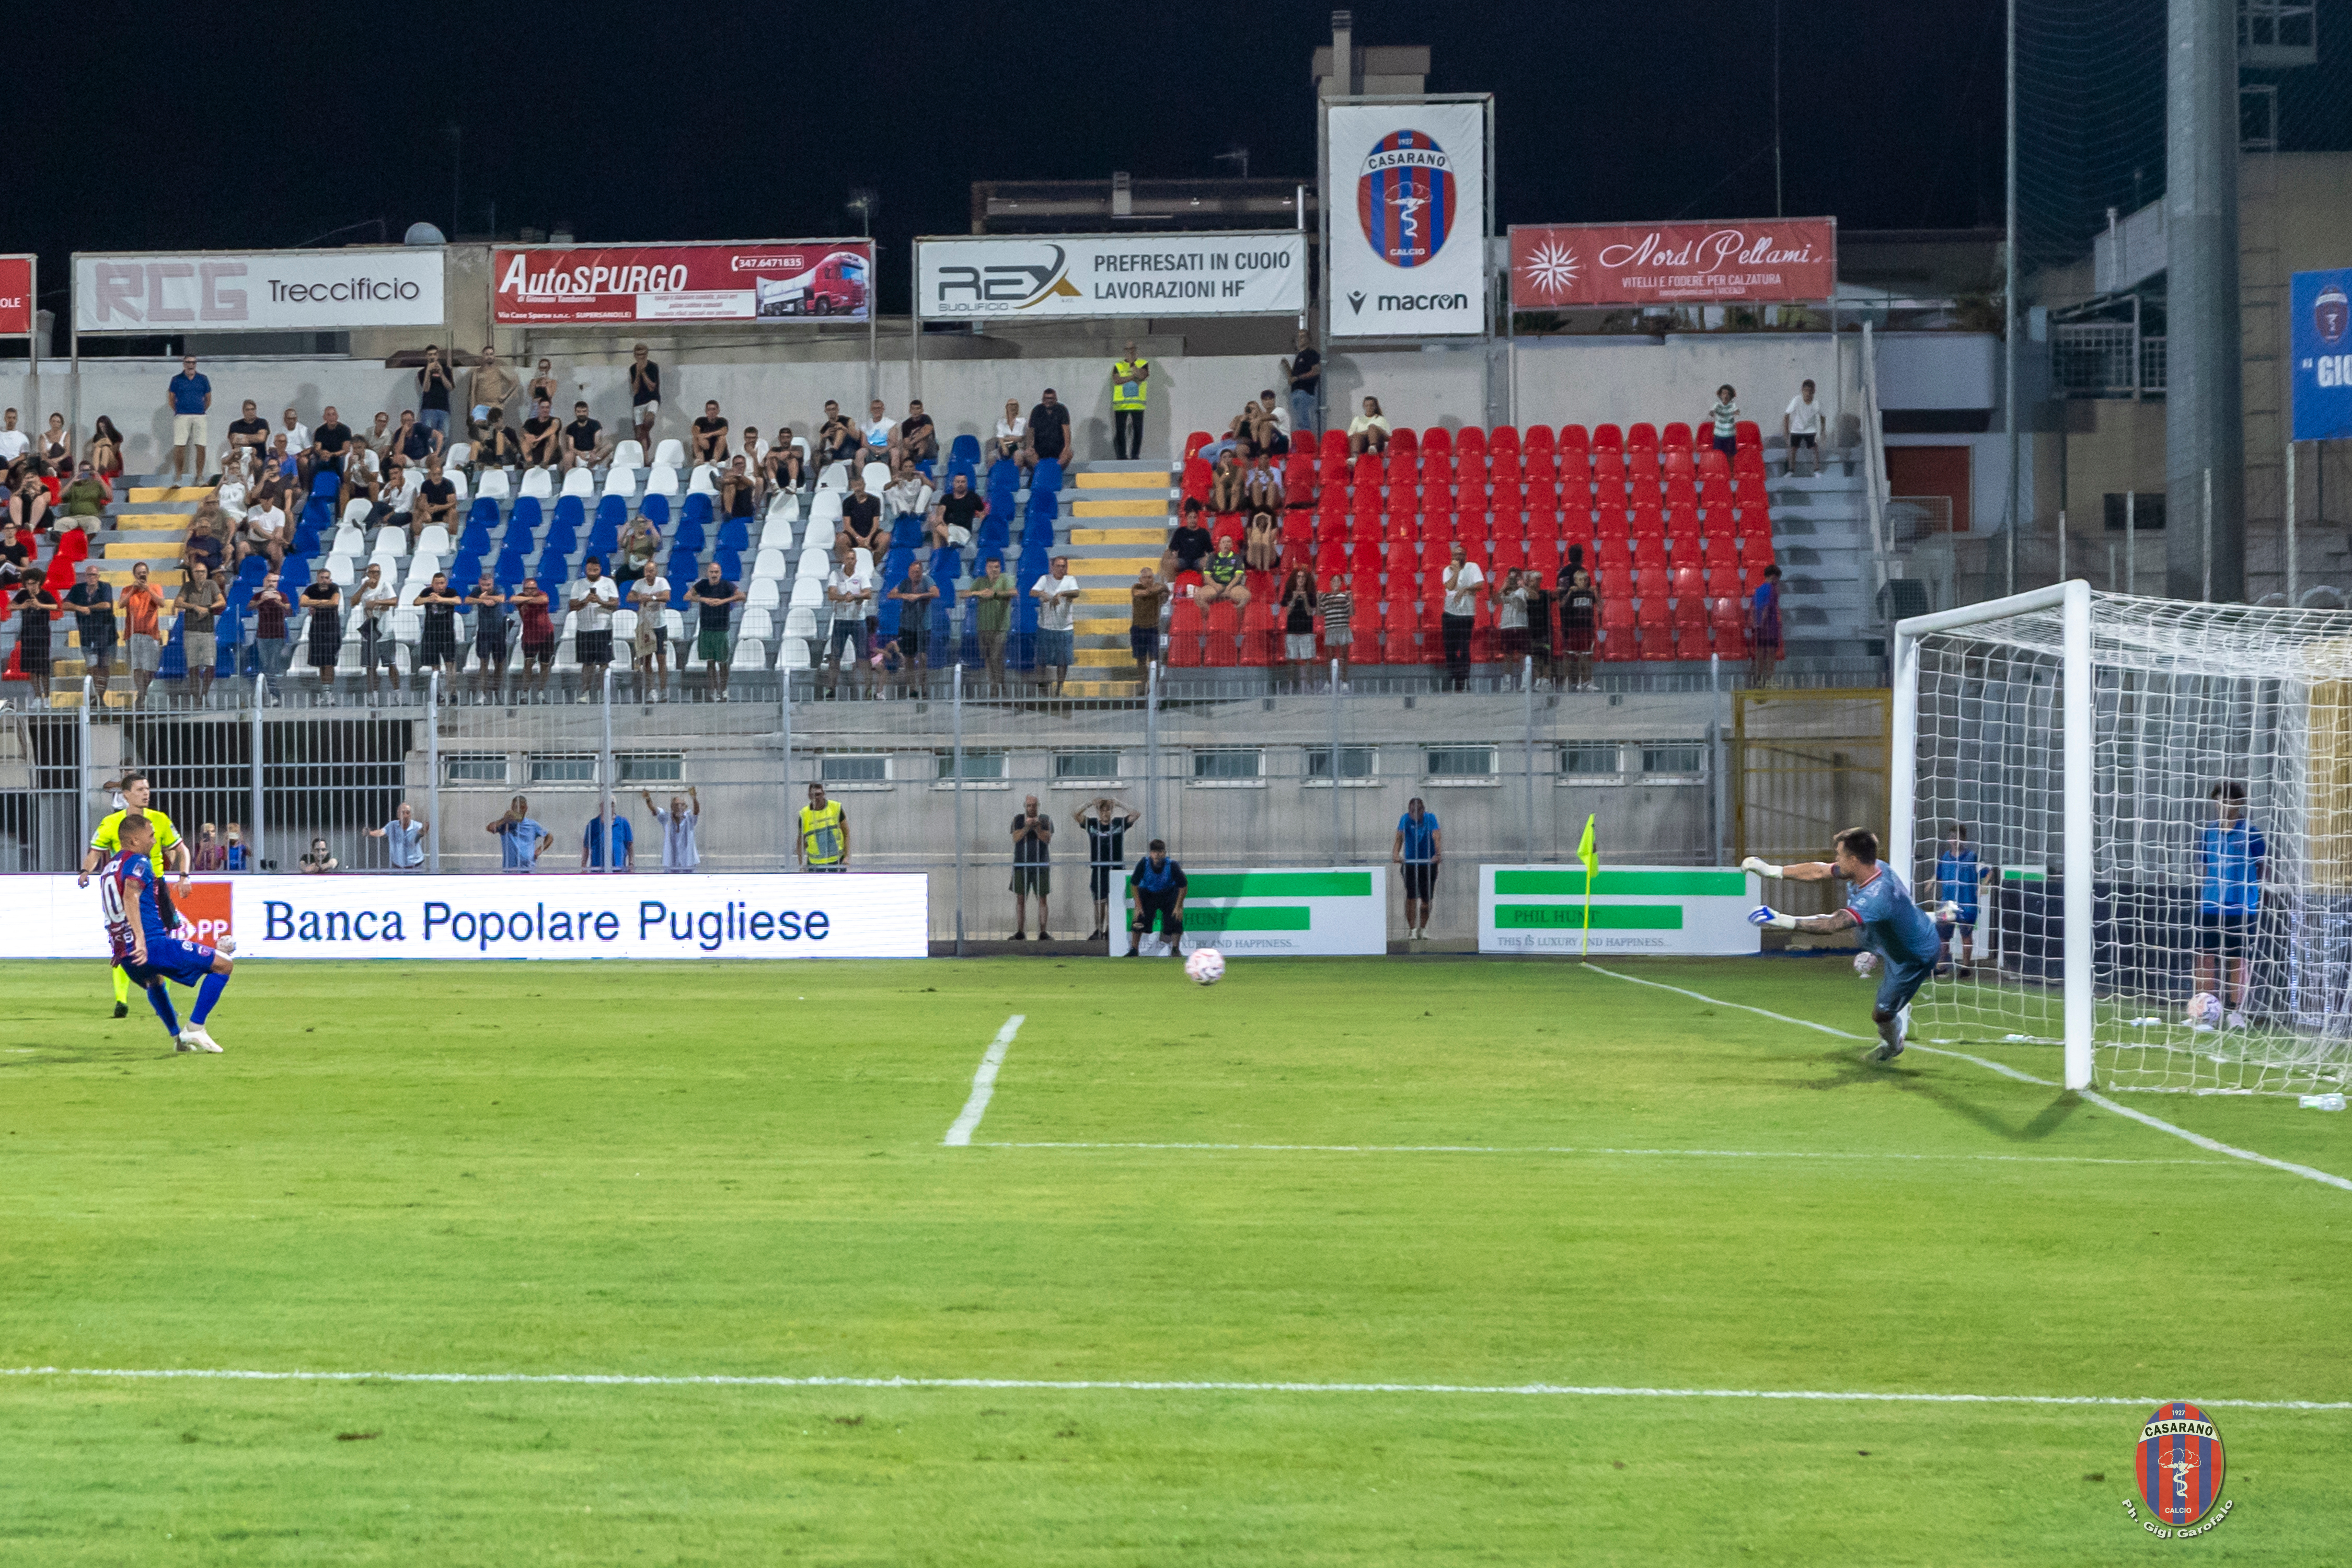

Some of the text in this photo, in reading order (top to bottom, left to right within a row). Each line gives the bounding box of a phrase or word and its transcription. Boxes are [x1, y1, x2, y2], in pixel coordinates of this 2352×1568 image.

[1368, 153, 1446, 170] CASARANO
[1389, 248, 1425, 256] CALCIO
[1599, 229, 1812, 274] Nord Pellami
[1094, 251, 1290, 272] PREFRESATI IN CUOIO
[498, 253, 688, 294] AutoSPURGO
[939, 244, 1083, 309] REX
[1622, 273, 1781, 288] VITELLI E FODERE PER CALZATURA
[95, 262, 420, 322] RCG Treccificio
[1094, 280, 1246, 299] LAVORAZIONI HF
[939, 303, 1009, 312] SUOLIFICIO
[1378, 293, 1468, 310] macron
[1514, 910, 1549, 923] PHIL
[262, 901, 830, 952] Banca Popolare Pugliese
[1497, 937, 1521, 947] THIS
[1524, 937, 1535, 947] IS
[1538, 937, 1578, 947] LUXURY
